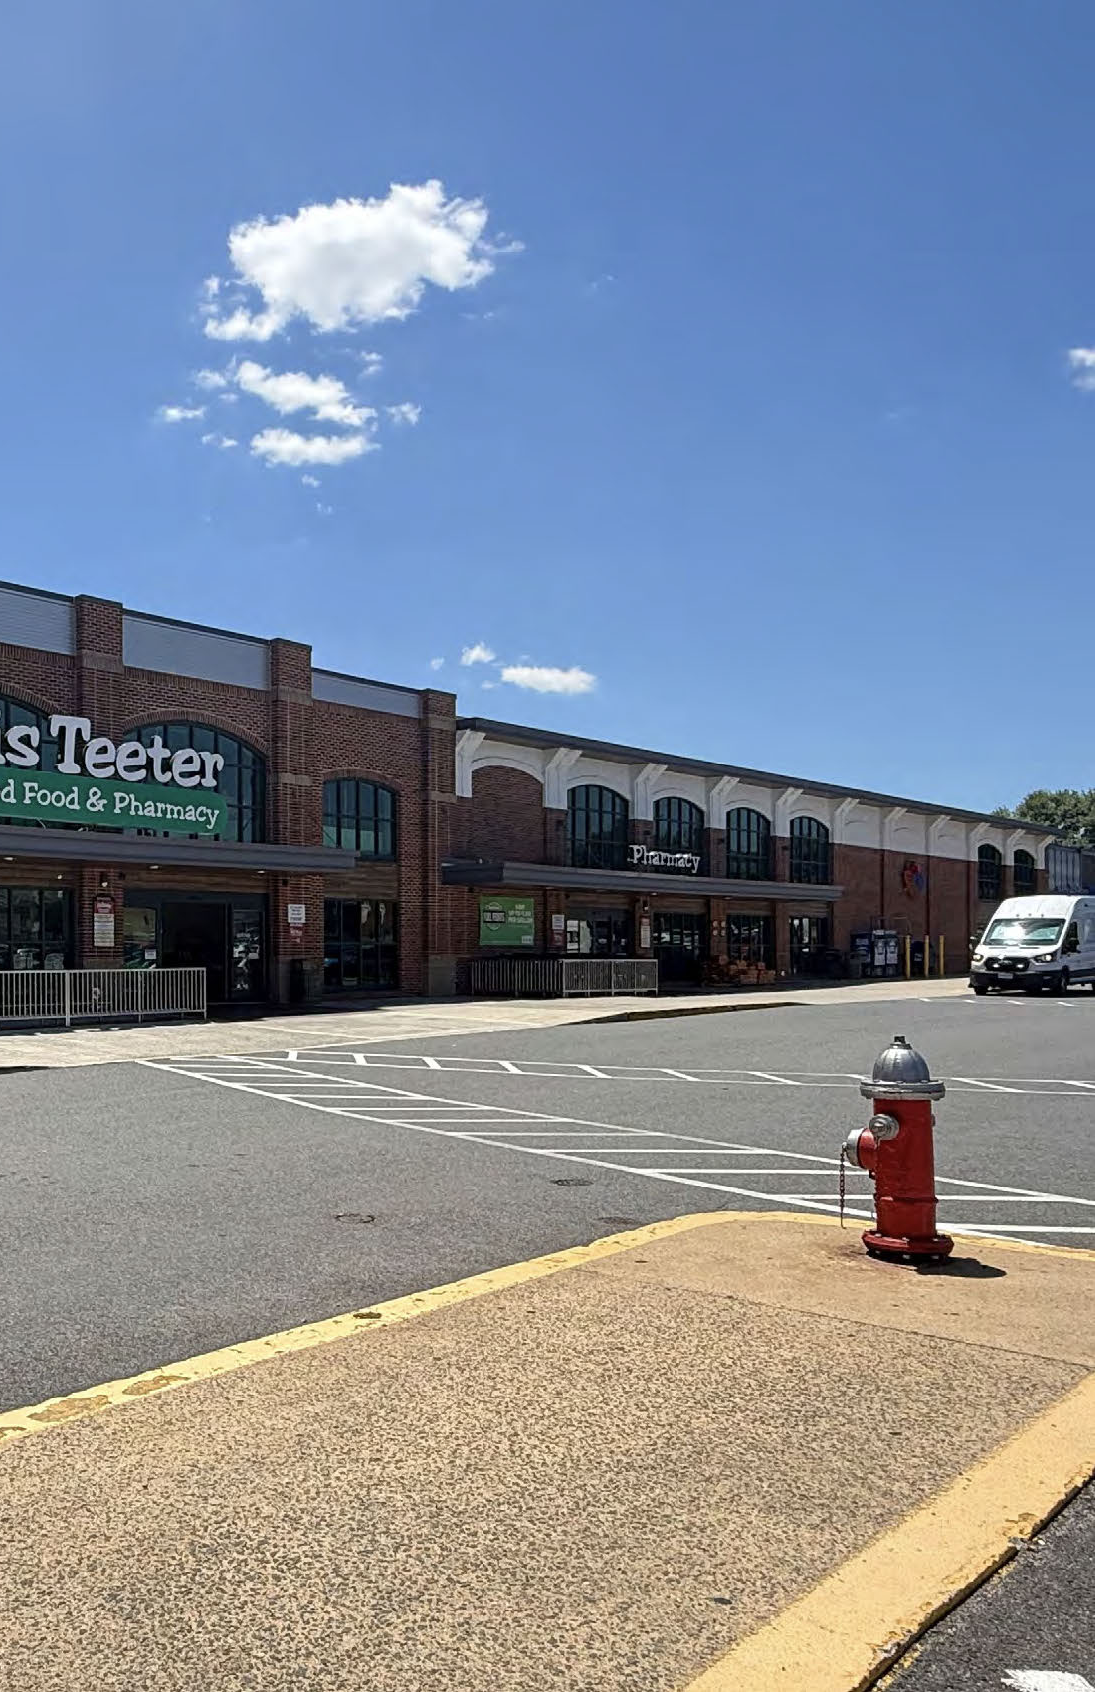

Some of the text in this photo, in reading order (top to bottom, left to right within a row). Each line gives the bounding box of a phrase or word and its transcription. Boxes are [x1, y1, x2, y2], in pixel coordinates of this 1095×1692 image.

[49, 714, 225, 788] Teeter
[23, 782, 81, 811] Food
[86, 787, 108, 812] &
[113, 791, 220, 830] Pharmacy
[627, 844, 701, 874] Pharmacy
